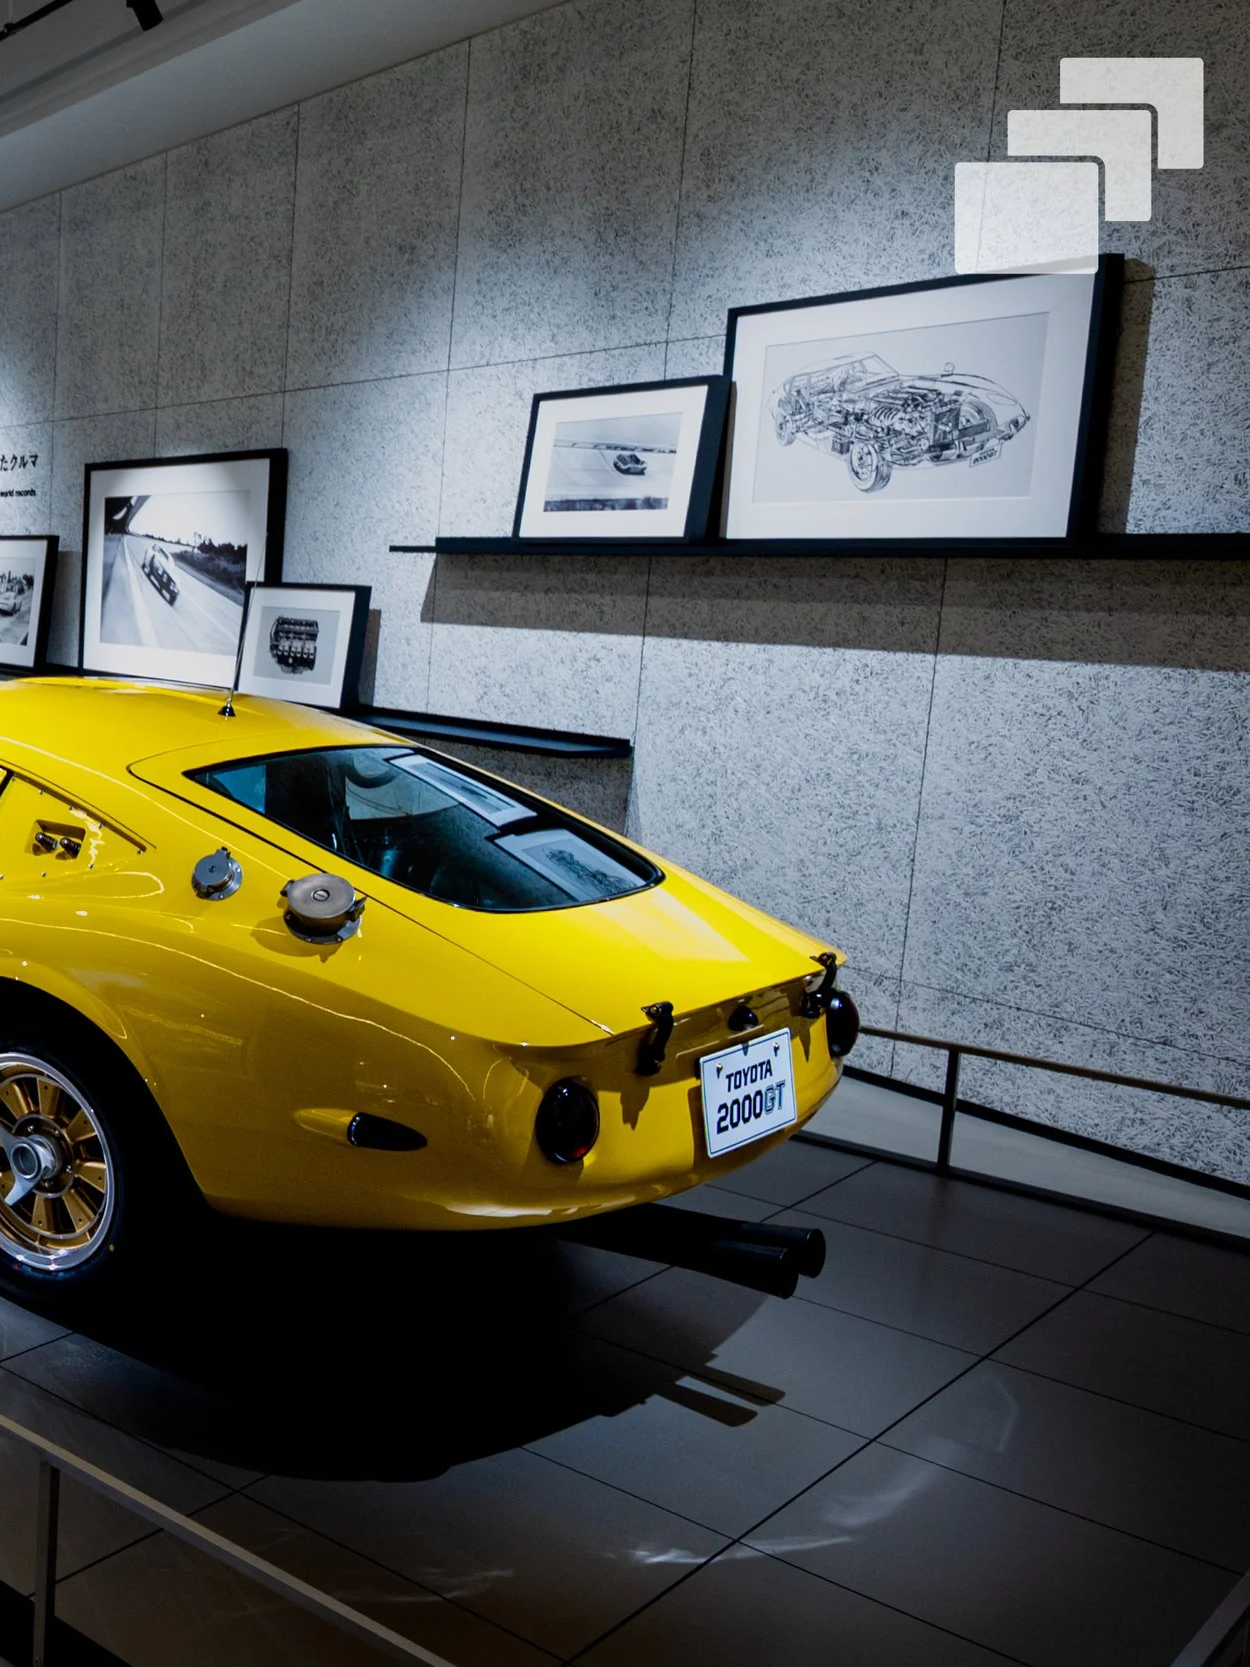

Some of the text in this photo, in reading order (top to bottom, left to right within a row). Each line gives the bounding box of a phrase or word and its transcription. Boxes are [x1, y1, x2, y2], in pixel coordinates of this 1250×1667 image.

[15, 487, 37, 497] records
[726, 1059, 773, 1093] TOYOTA
[716, 1080, 786, 1135] 2000GT
